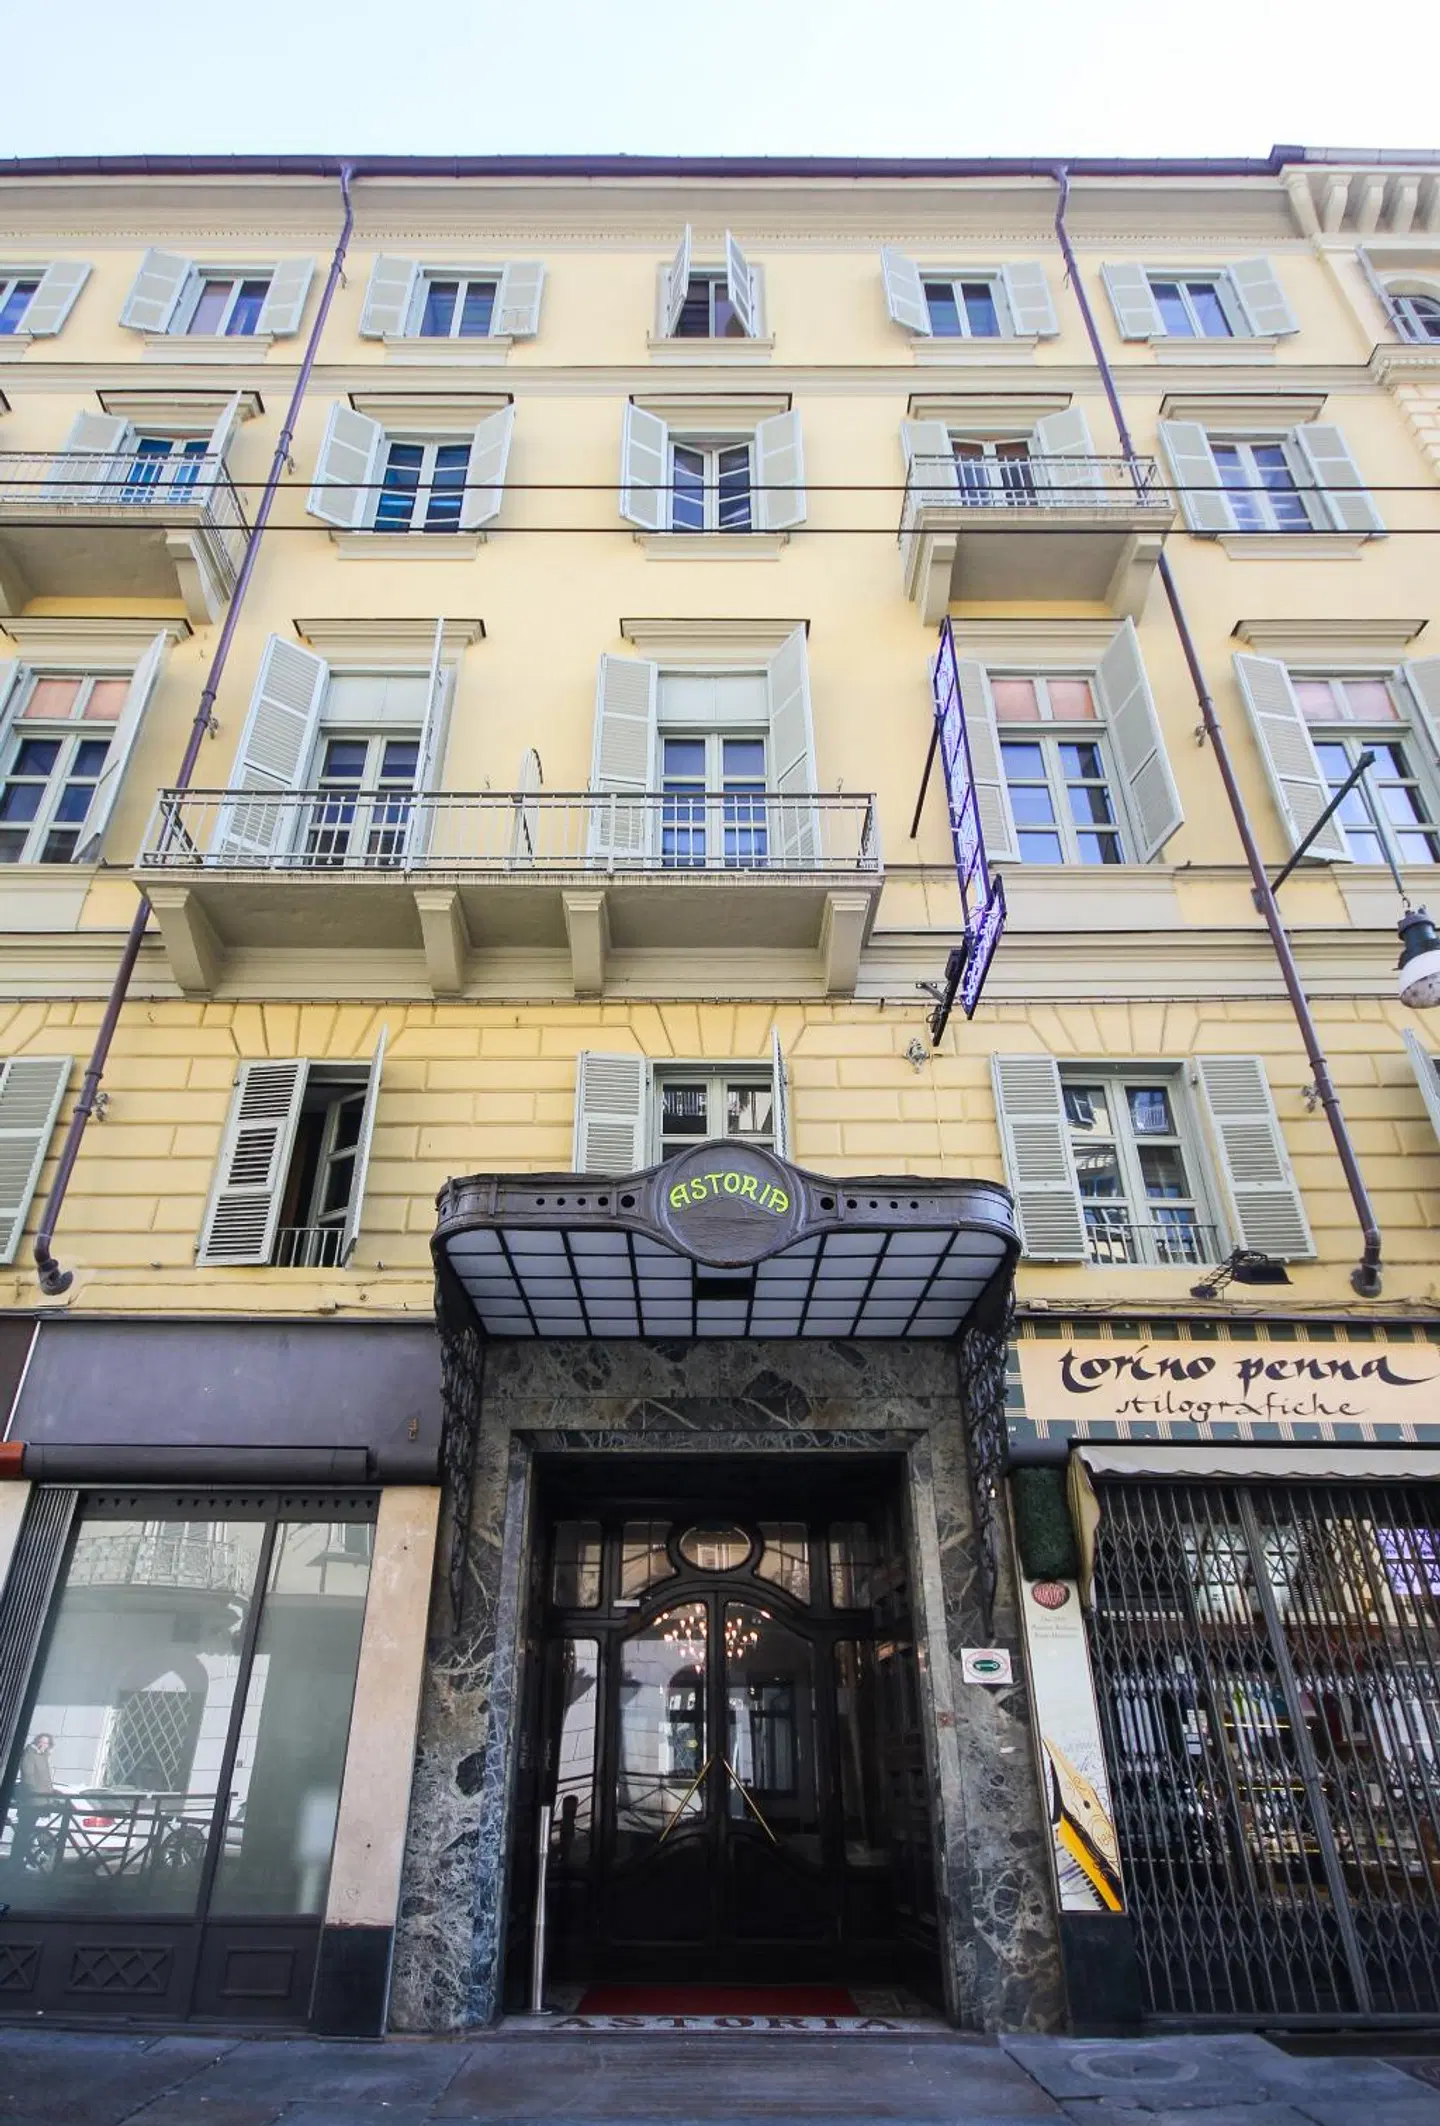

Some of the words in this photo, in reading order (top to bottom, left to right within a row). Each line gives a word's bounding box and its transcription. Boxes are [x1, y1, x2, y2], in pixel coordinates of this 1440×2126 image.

[669, 1171, 790, 1213] ASTORIA
[1058, 1344, 1216, 1394] torino
[1233, 1354, 1439, 1397] penna
[1115, 1391, 1366, 1422] stilografiche
[550, 2016, 903, 2029] ASTORIA
